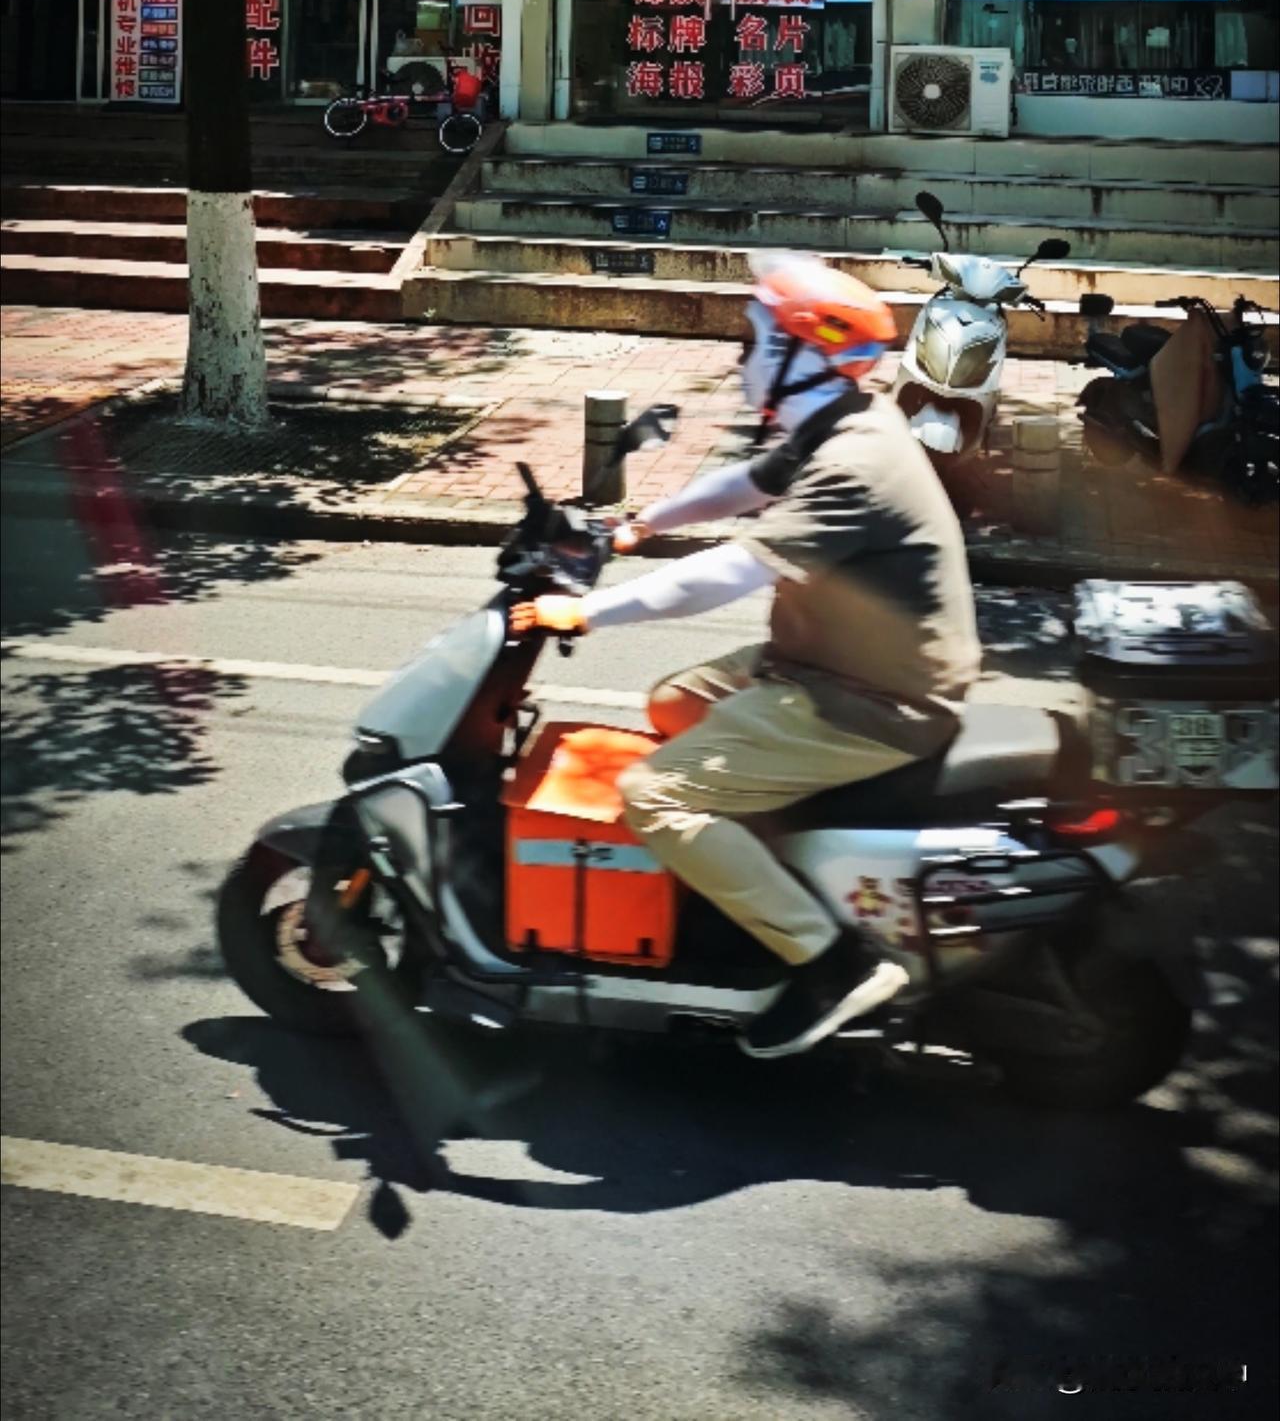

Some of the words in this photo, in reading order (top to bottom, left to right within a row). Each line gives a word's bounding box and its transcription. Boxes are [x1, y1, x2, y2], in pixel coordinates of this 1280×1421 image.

[626, 14, 707, 53] 标牌
[735, 13, 811, 53] 名片
[625, 60, 706, 98] 海报
[727, 61, 808, 98] 彩页
